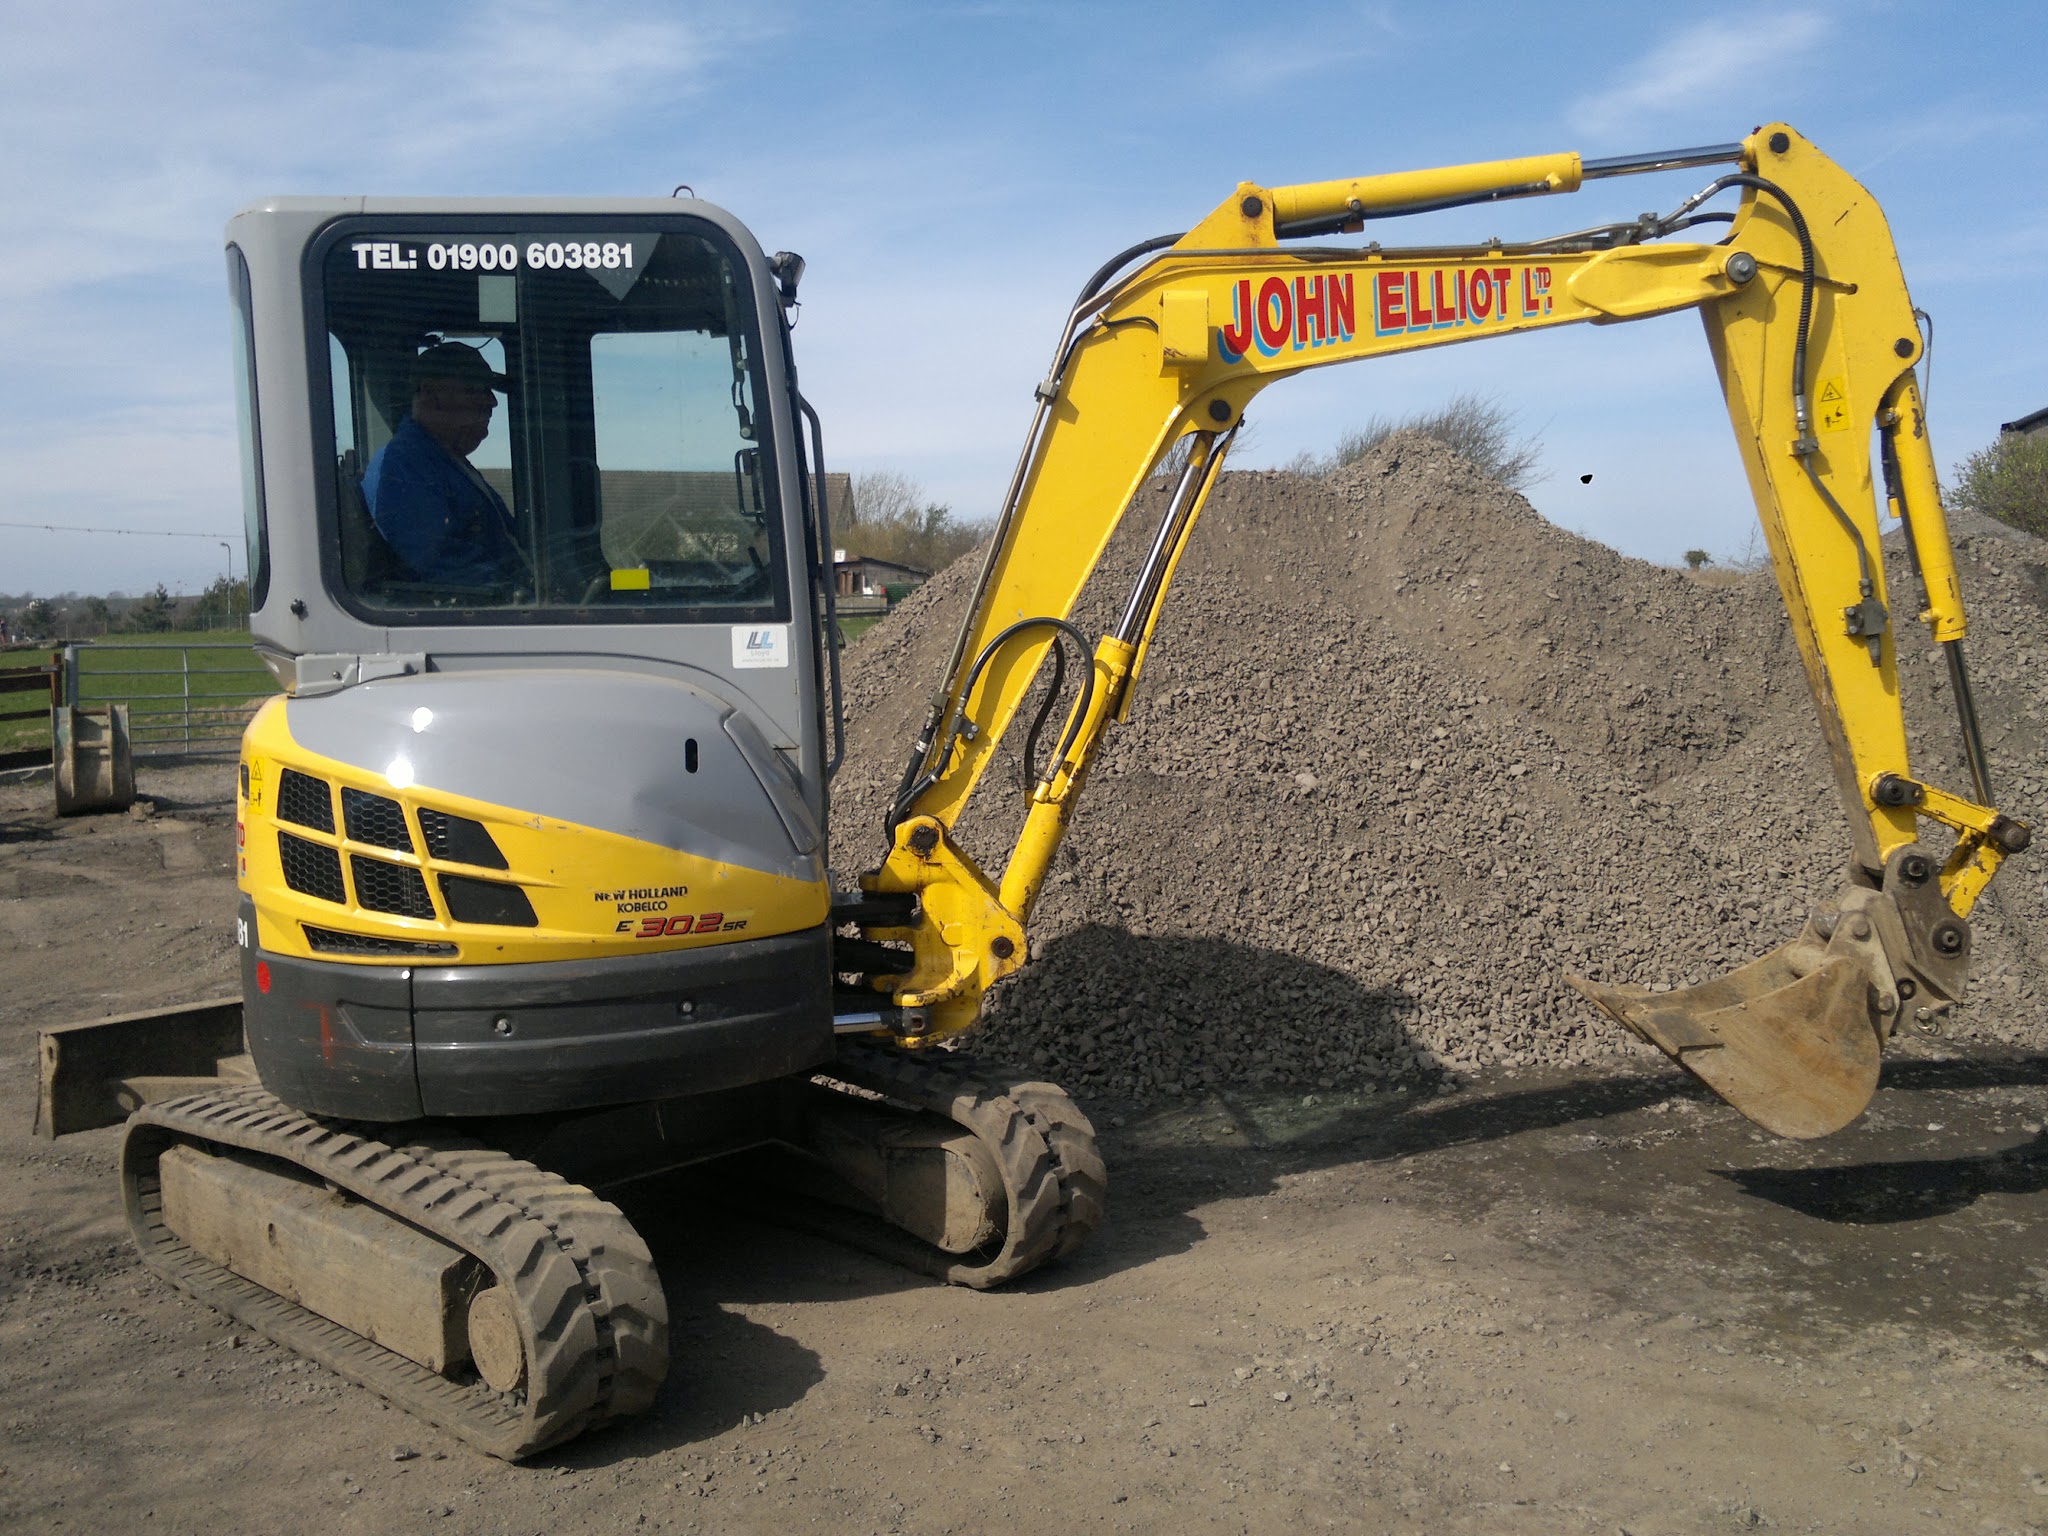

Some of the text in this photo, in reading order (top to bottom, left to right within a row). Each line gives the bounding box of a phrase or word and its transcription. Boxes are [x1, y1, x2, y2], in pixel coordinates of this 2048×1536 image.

[352, 242, 633, 270] TEL: 01900 603881
[1218, 273, 1355, 364] JOHN
[1373, 268, 1511, 337] ELLIOT
[594, 886, 688, 901] NEW HOLLAND
[617, 901, 668, 913] KOBELCO
